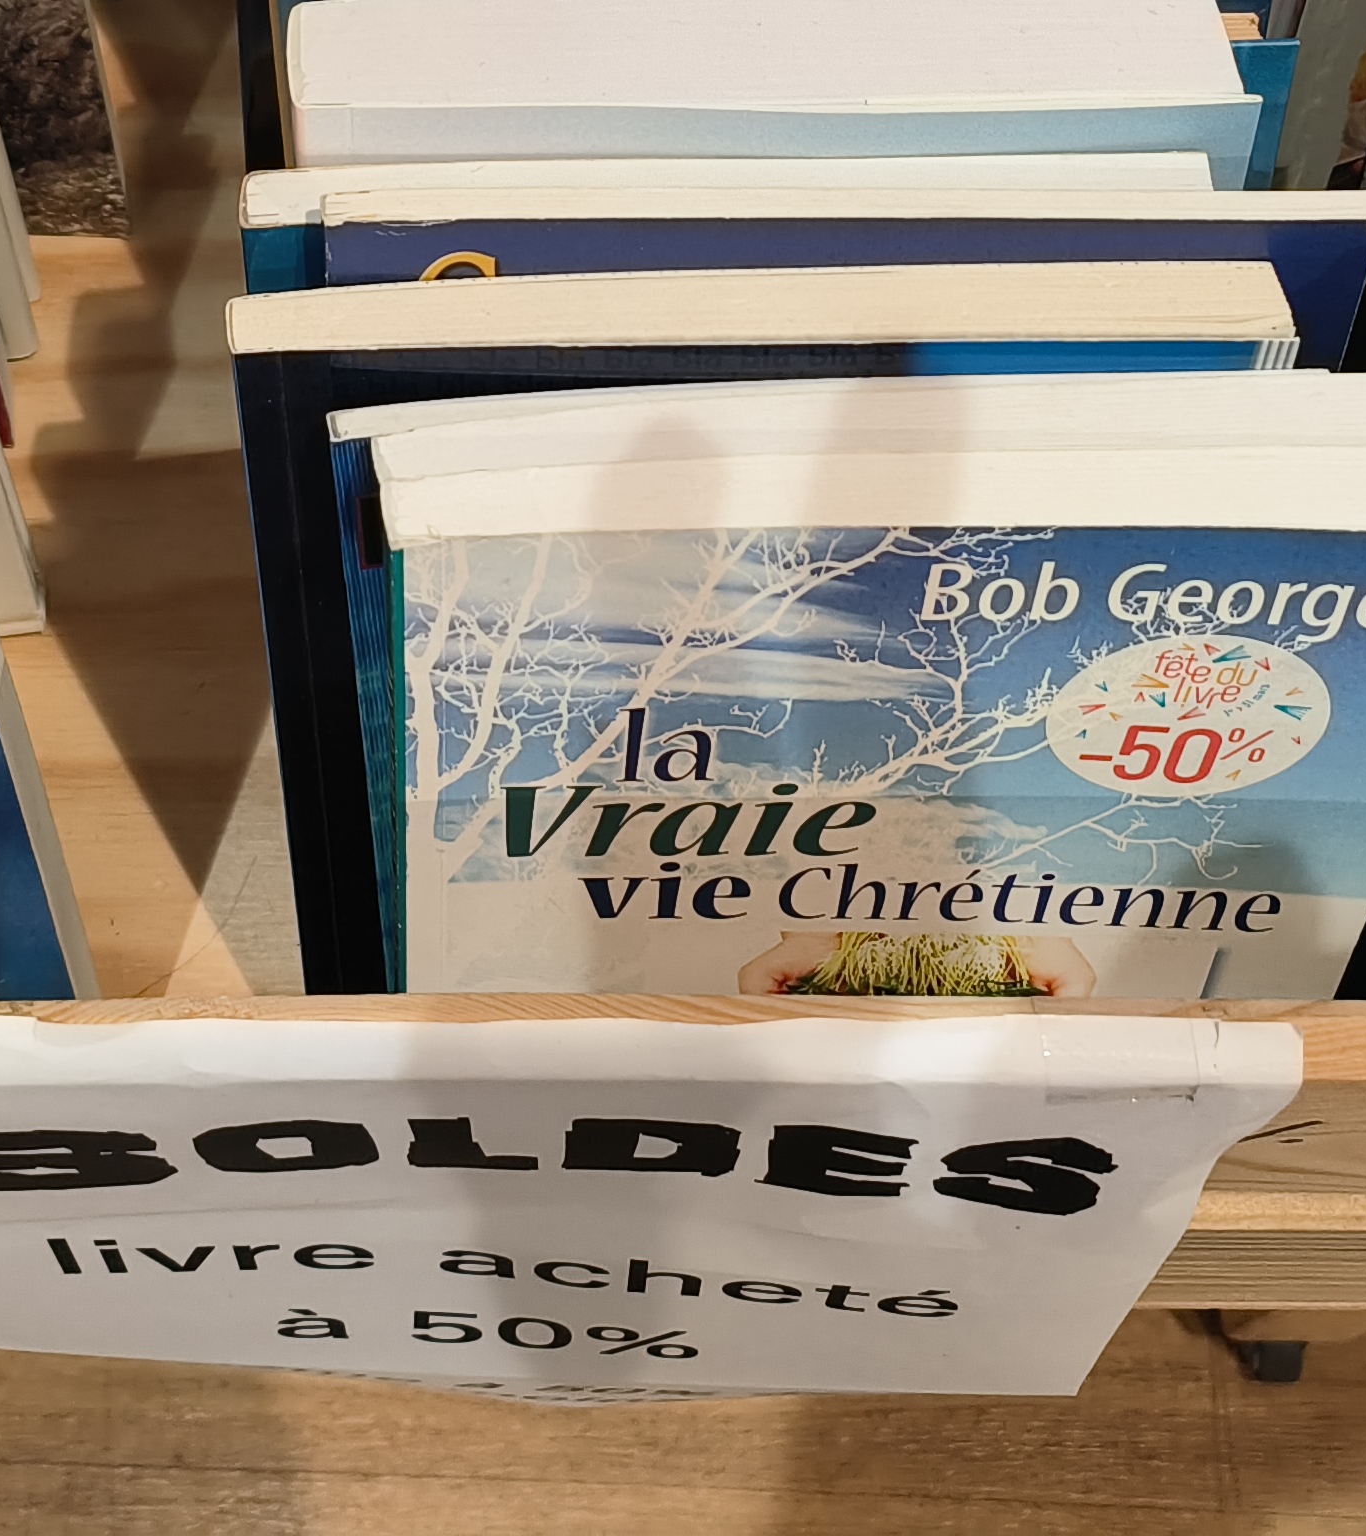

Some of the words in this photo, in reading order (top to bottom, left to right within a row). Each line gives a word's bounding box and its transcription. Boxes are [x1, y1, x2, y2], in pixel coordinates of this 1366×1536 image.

[919, 560, 1081, 630] Bob
[1154, 650, 1211, 684] fête
[1216, 661, 1258, 686] du
[1173, 676, 1241, 709] livre
[618, 708, 715, 782] la
[1079, 725, 1274, 783] -50%
[501, 781, 877, 859] Vraie
[579, 861, 750, 925] vie
[776, 862, 1282, 935] Chrétienne
[49, 1236, 376, 1279] livre
[440, 1241, 961, 1322] acheté
[277, 1309, 349, 1343] à
[410, 1309, 701, 1363] 50%
